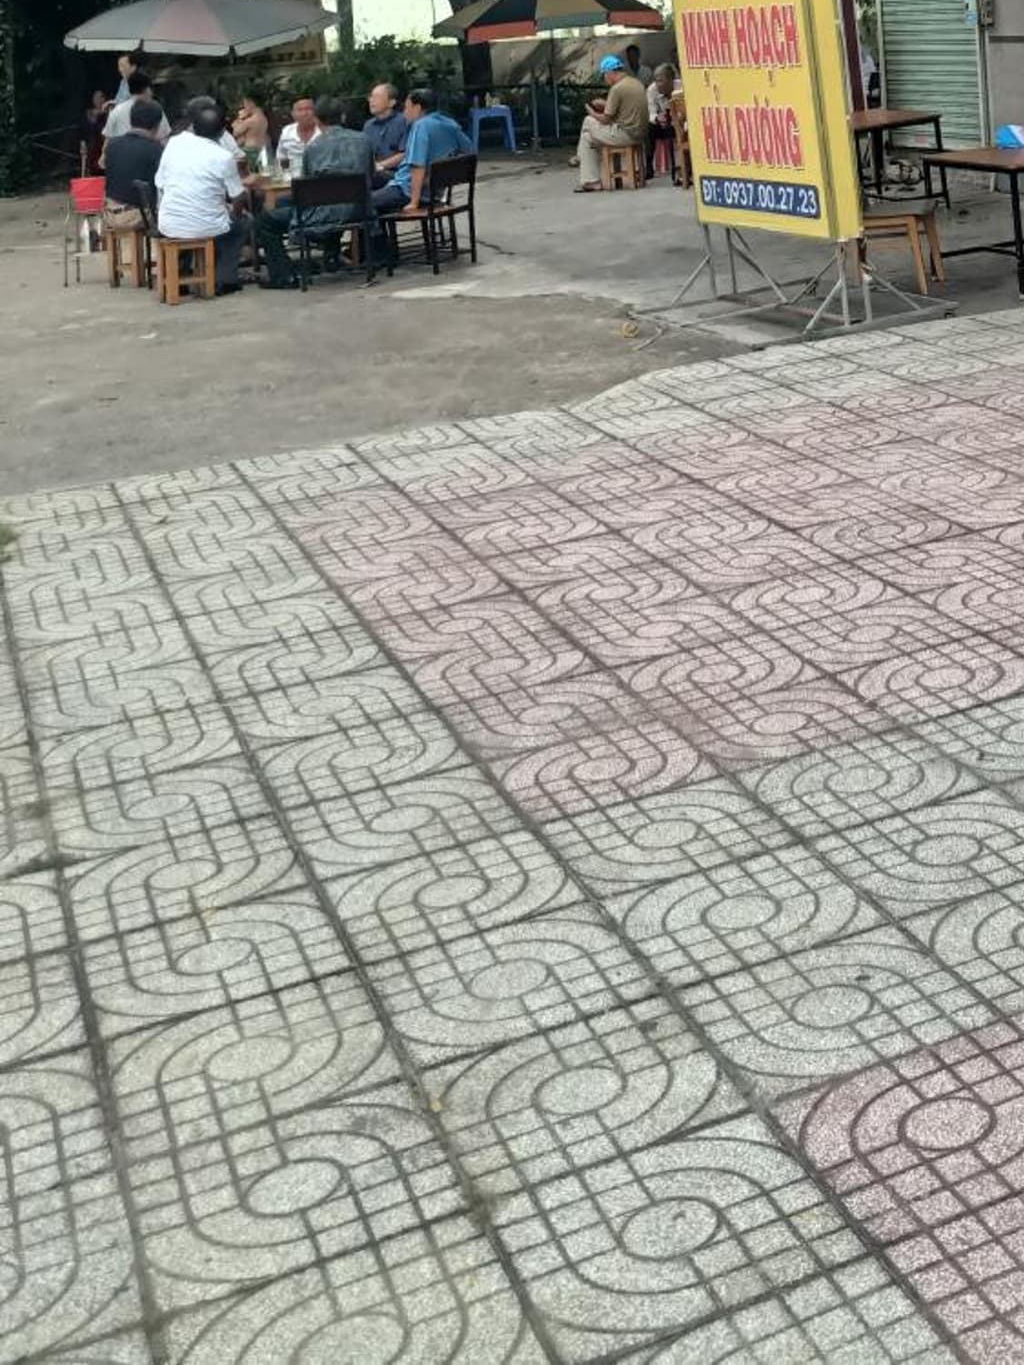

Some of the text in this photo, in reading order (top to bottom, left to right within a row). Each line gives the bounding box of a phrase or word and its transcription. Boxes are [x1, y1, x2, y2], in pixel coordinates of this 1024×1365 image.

[681, 3, 802, 88] MẠNH HOẠCH
[701, 82, 805, 171] HẢI DƯƠNG
[702, 182, 722, 207] ĐT:
